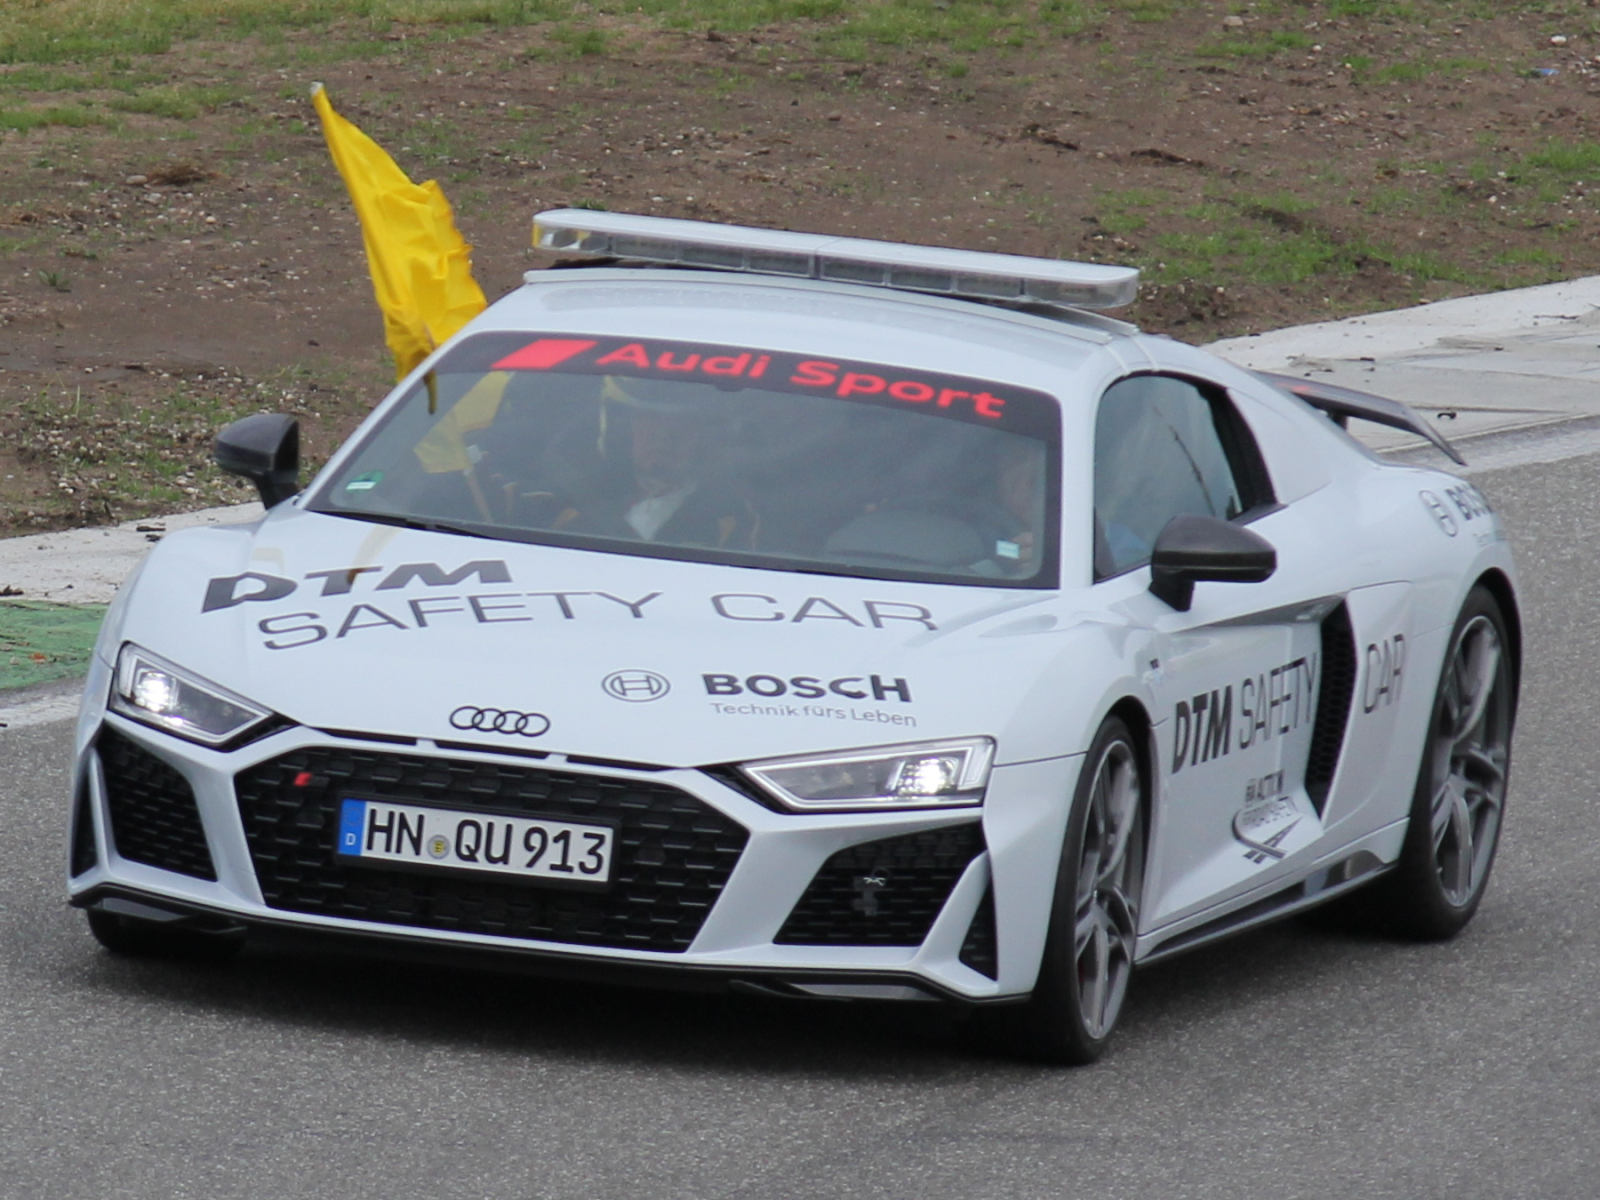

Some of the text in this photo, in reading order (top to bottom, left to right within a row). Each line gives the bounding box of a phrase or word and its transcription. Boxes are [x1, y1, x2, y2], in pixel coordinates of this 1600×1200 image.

[596, 342, 1006, 418] Audi Sport
[201, 560, 513, 614] DTM
[257, 591, 939, 650] SAFETY CAR
[701, 673, 913, 703] BOSCH
[709, 702, 918, 728] Technik fürs Leben
[1171, 633, 1407, 775] DTM SAFETY CAR
[345, 832, 357, 846] D
[366, 808, 607, 875] HN QU 913
